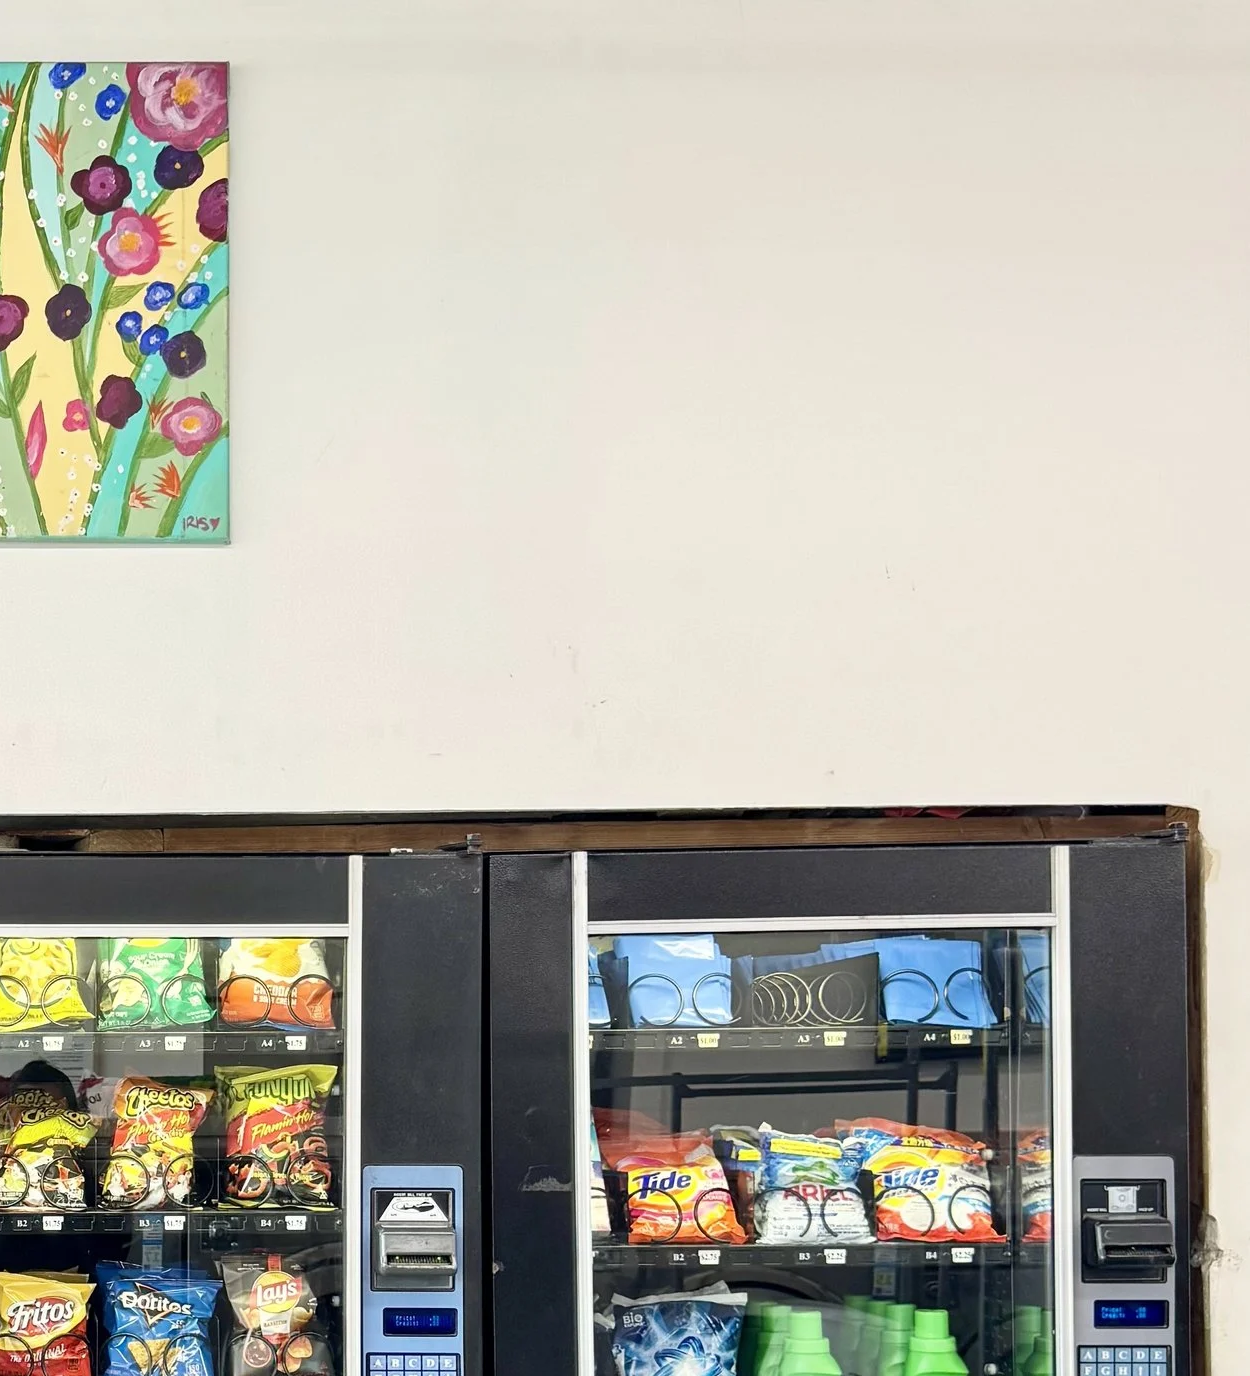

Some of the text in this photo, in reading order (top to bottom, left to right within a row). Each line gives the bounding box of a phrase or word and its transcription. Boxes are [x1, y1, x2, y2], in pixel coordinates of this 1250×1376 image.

[183, 516, 210, 532] IRIS
[671, 1036, 683, 1045] A2
[798, 1035, 809, 1043] A3
[924, 1033, 936, 1042] A4
[18, 1040, 30, 1048] A2
[139, 1040, 150, 1048] A3
[261, 1040, 273, 1048] A4
[244, 1076, 317, 1106] FUNYUN
[126, 1086, 195, 1117] Cheetos
[251, 1109, 317, 1143] Flamin' Hot
[632, 1171, 692, 1200] Tide
[17, 1220, 28, 1228] B2
[43, 1220, 59, 1228] $1.75
[139, 1220, 150, 1228] B3
[260, 1220, 272, 1228] B4
[673, 1253, 684, 1261] B2
[799, 1253, 810, 1261] B3
[926, 1251, 937, 1260] B4
[256, 1280, 298, 1308] Lay's
[117, 1291, 194, 1315] Doritos
[7, 1300, 75, 1333] Fritos
[1084, 1351, 1162, 1360] A B C D E
[374, 1359, 453, 1367] A B C D E
[1085, 1366, 1127, 1376] F G H
